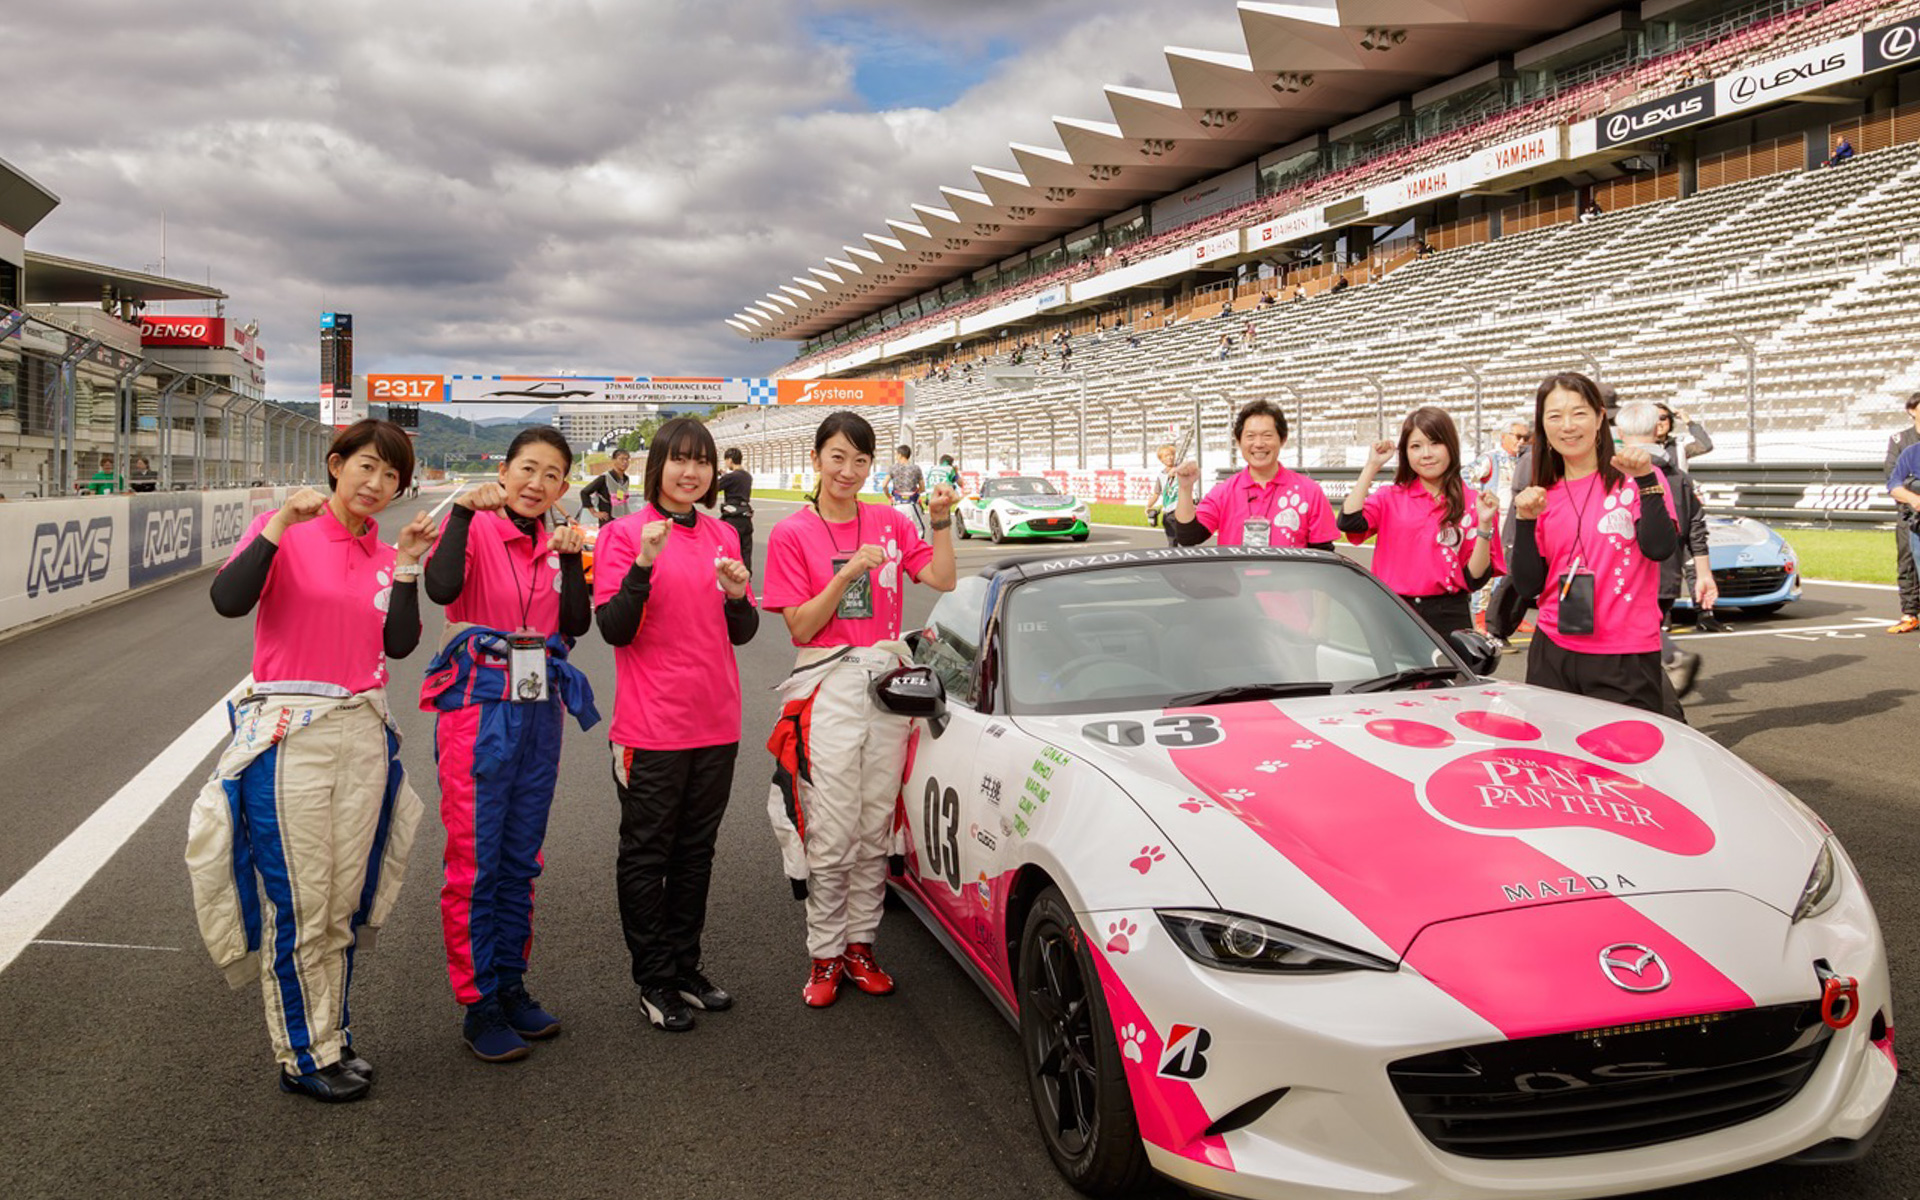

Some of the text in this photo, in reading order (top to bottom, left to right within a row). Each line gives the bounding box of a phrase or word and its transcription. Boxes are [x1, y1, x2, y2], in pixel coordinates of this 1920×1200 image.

[1759, 53, 1846, 90] LEXUS
[1630, 97, 1703, 130] LEXUS
[1495, 138, 1545, 170] YAMAHA
[1406, 172, 1448, 199] YAMAHA
[140, 323, 206, 338] DENSO
[374, 380, 436, 397] 2317
[813, 387, 864, 402] systena
[144, 508, 194, 568] RAYS
[212, 503, 243, 548] RAYS
[27, 517, 113, 598] RAYS
[1043, 547, 1318, 571] MAZDA SPIRIT RACING
[1082, 714, 1226, 748] 03
[1500, 757, 1540, 769] TEAM
[1473, 759, 1638, 804] PINK
[1474, 785, 1664, 830] PANTHER
[924, 776, 961, 895] 03
[1503, 874, 1636, 901] MAZDA
